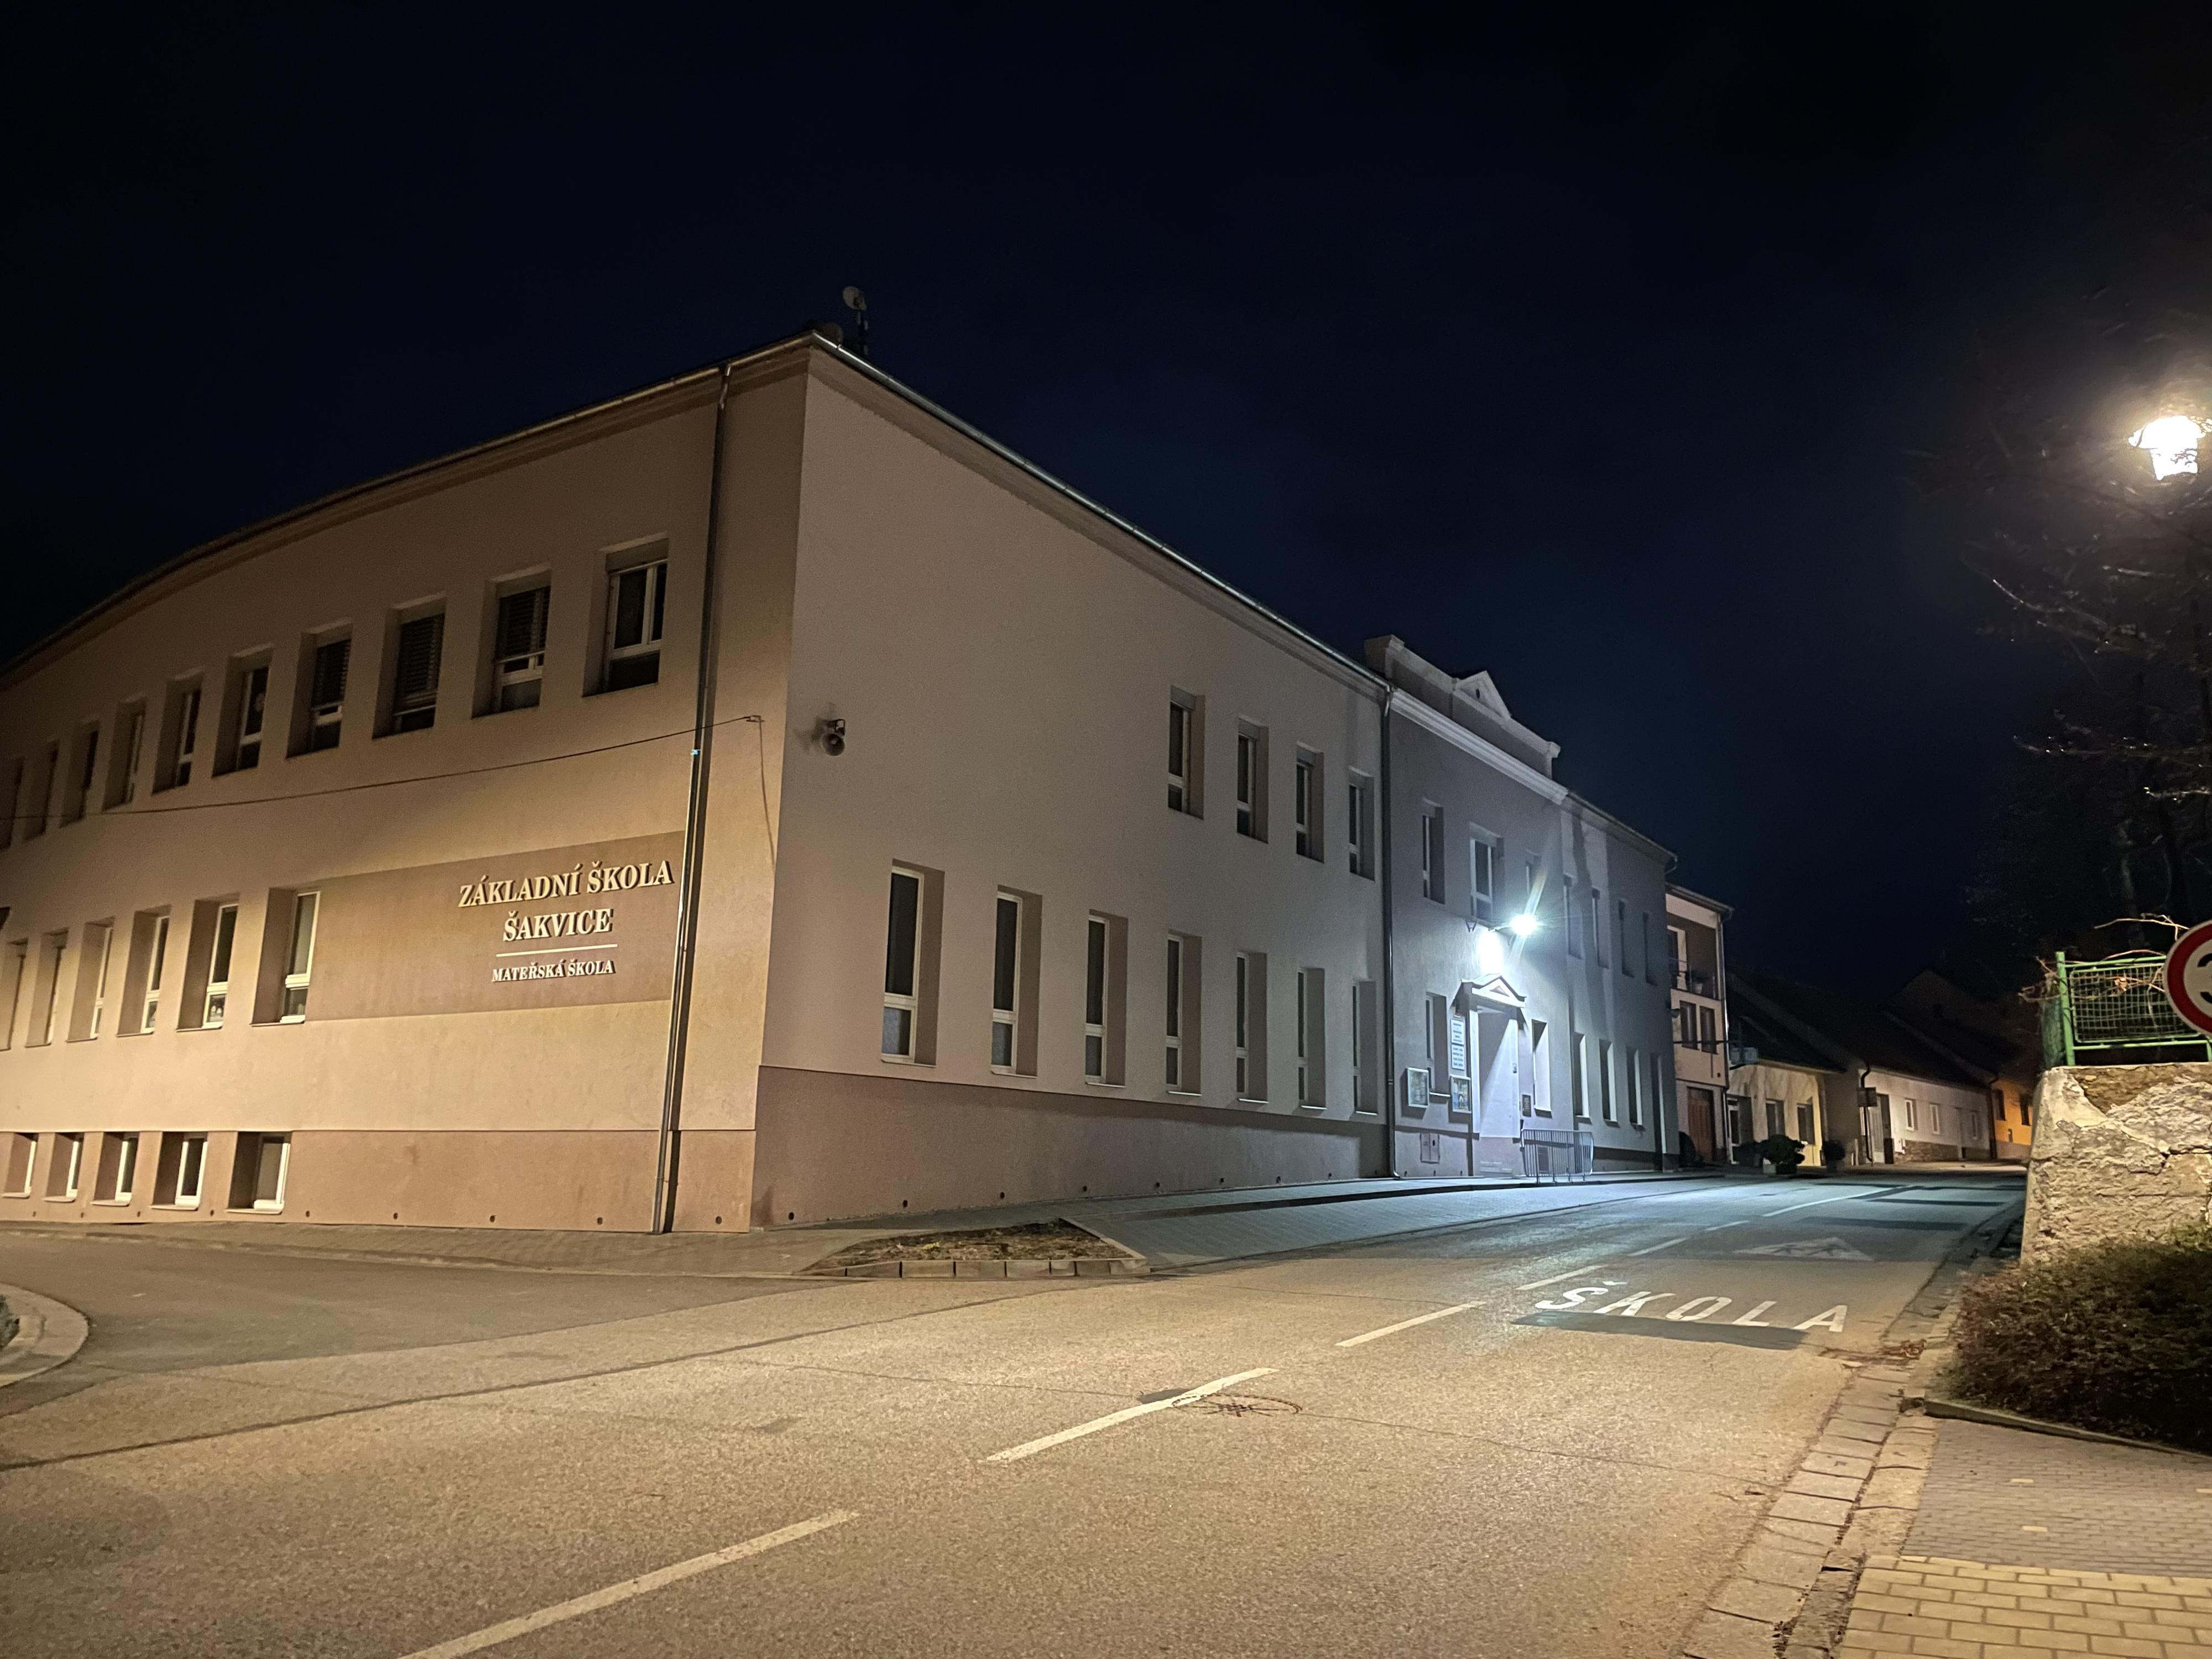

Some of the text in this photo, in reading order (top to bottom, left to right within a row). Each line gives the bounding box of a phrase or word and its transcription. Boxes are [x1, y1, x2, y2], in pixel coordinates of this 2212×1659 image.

[458, 860, 674, 907] ZÁKLADNÍ ŠKOLA
[503, 908, 613, 942] ŠAKVICE
[492, 958, 615, 983] MATEŘSKÁ ŠKOLA
[1535, 1280, 1848, 1333] ŠKOLA
